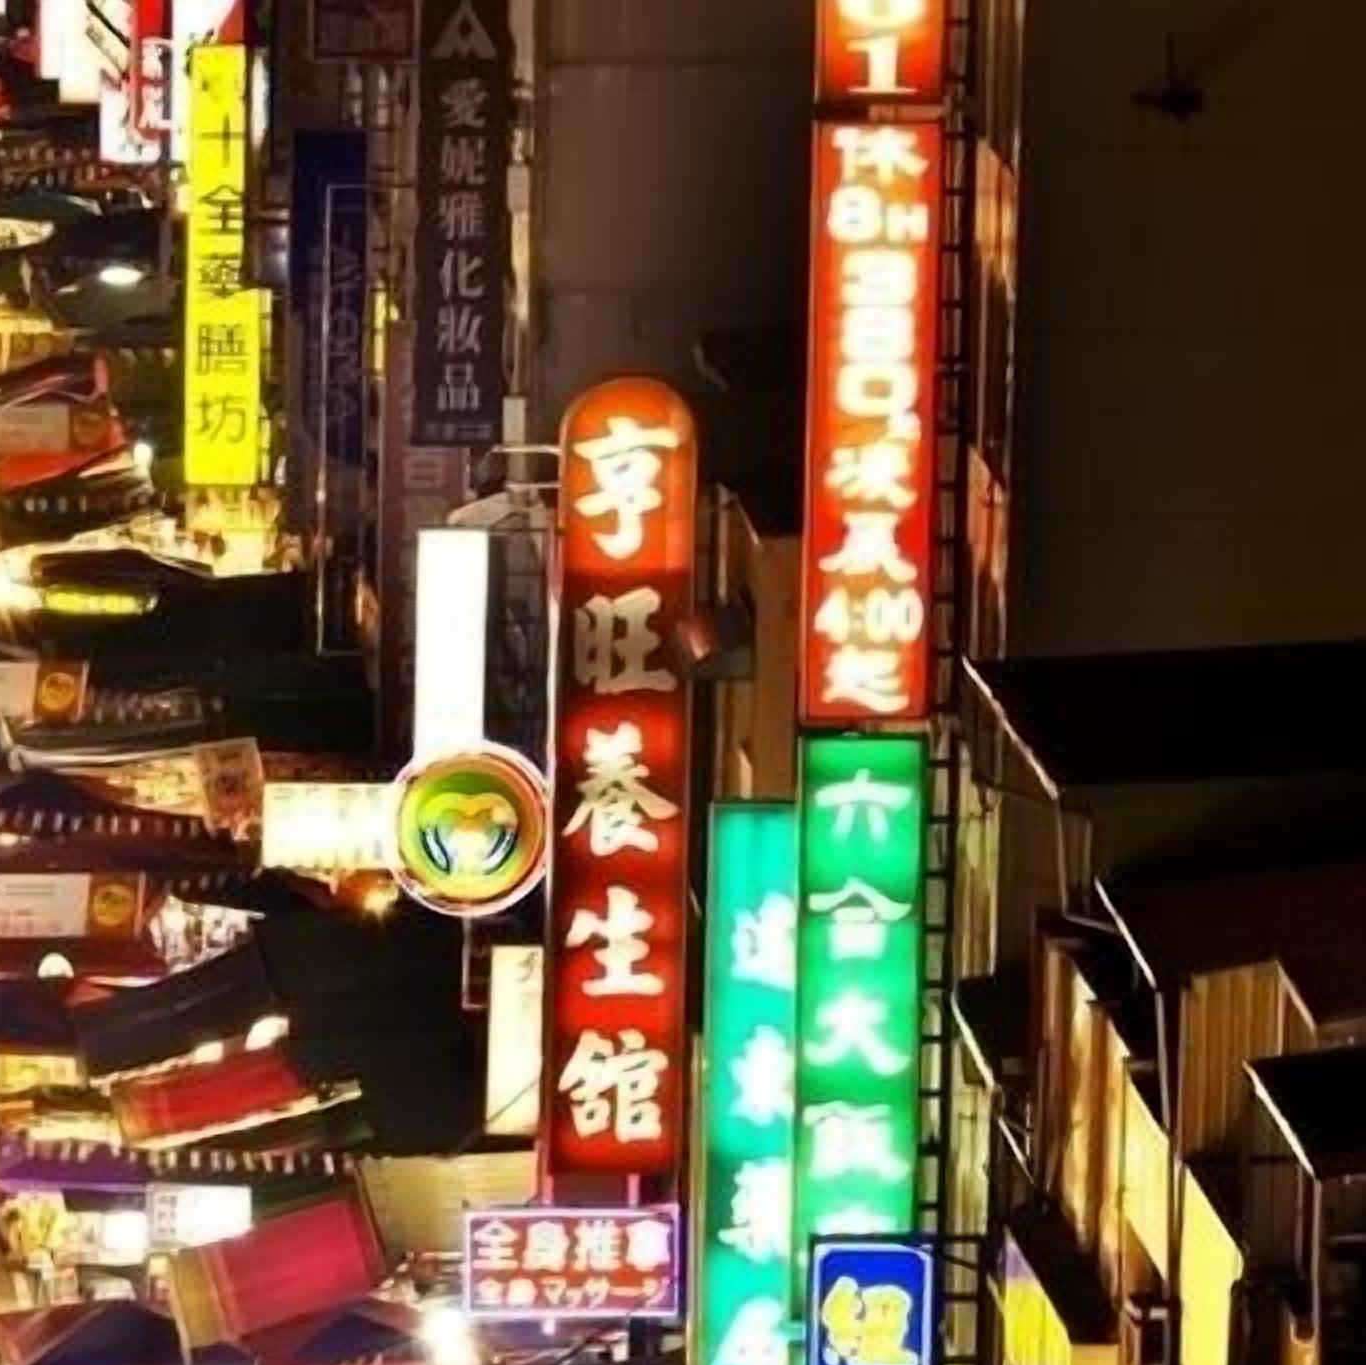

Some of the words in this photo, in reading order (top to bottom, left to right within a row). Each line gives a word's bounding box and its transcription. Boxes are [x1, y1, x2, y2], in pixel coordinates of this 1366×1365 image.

[194, 115, 250, 446] 十全藥膳坊
[437, 78, 490, 412] 愛妮雅化妝品
[558, 415, 679, 1144] 亨旺養生館
